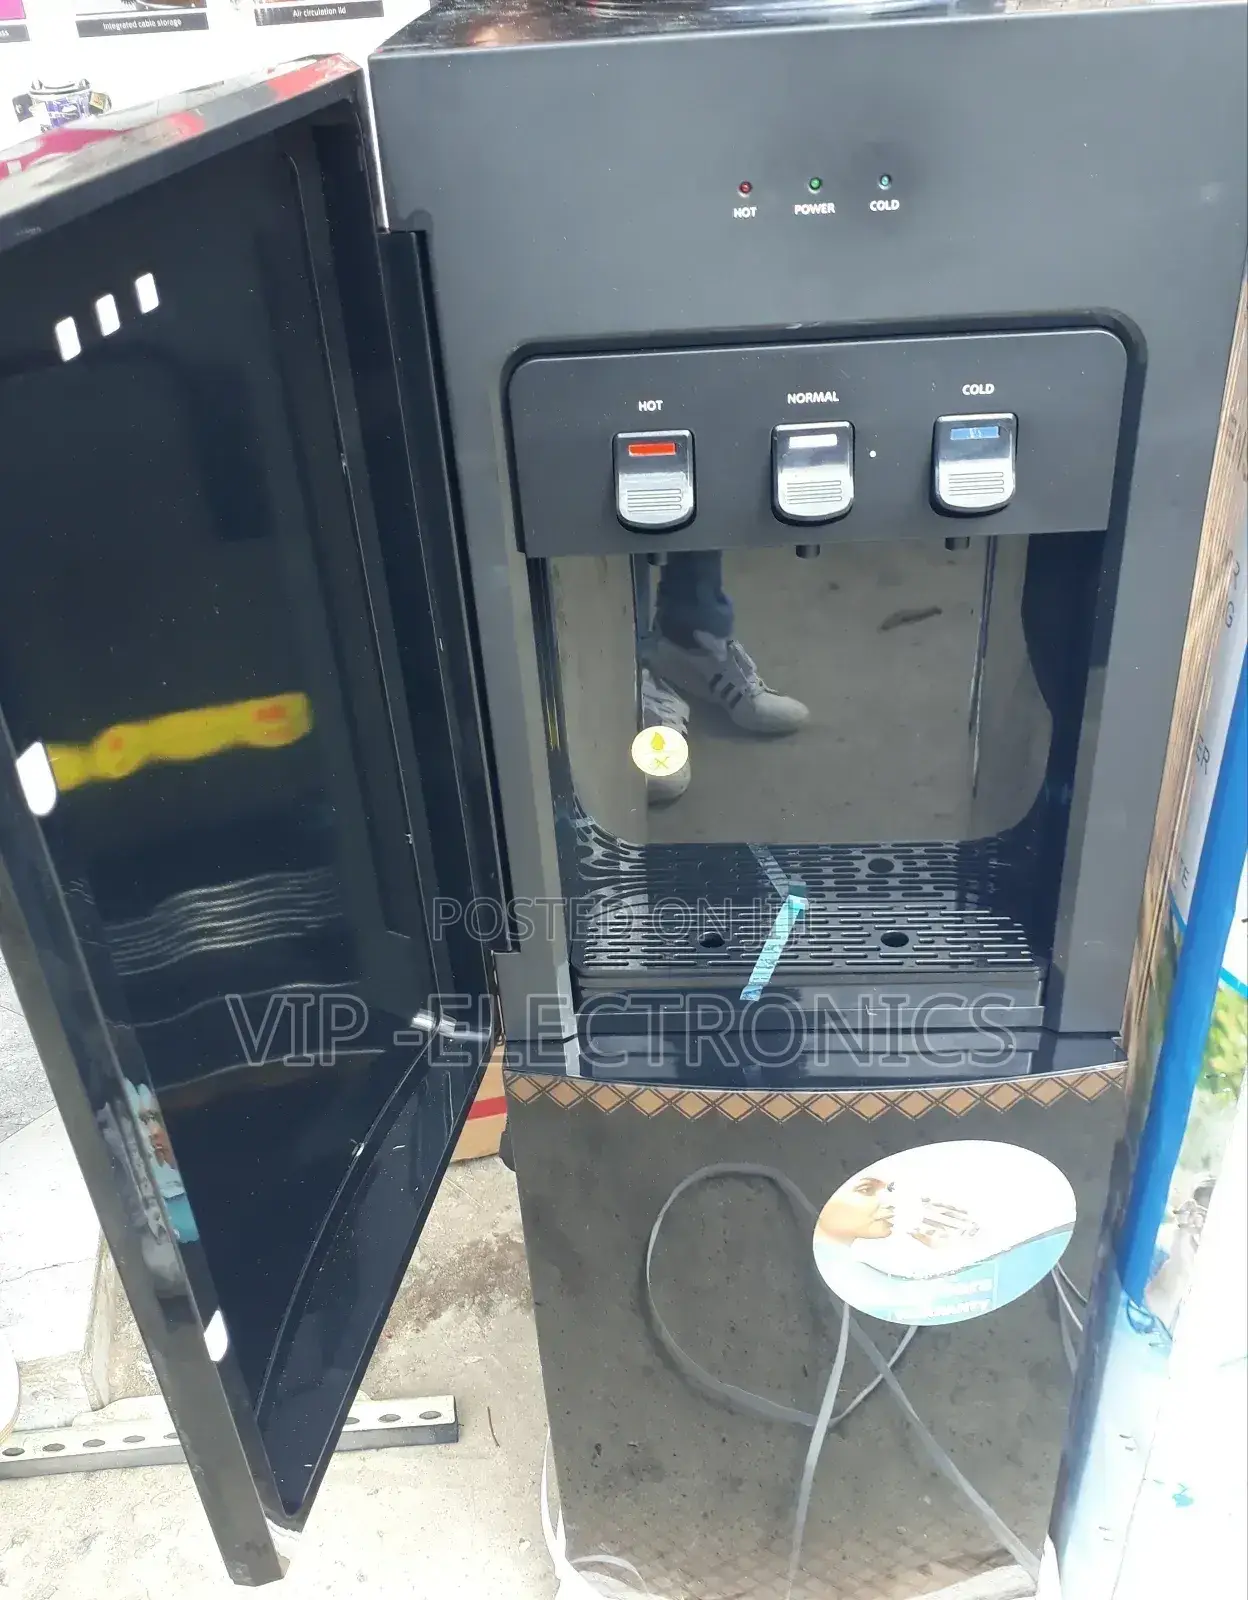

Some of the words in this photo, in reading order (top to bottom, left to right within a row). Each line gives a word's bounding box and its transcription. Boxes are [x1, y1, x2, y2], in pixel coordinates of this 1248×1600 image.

[292, 9, 302, 18] Air
[303, 7, 337, 17] circulation
[337, 6, 347, 15] lid
[102, 21, 138, 31] Integrated
[138, 19, 156, 29] cable
[157, 18, 182, 28] storage
[733, 206, 757, 219] HOT
[794, 202, 836, 215] POWER
[869, 199, 900, 212] COLD
[962, 383, 995, 396] COLD
[787, 390, 840, 405] NORMAL
[638, 399, 663, 412] HOT
